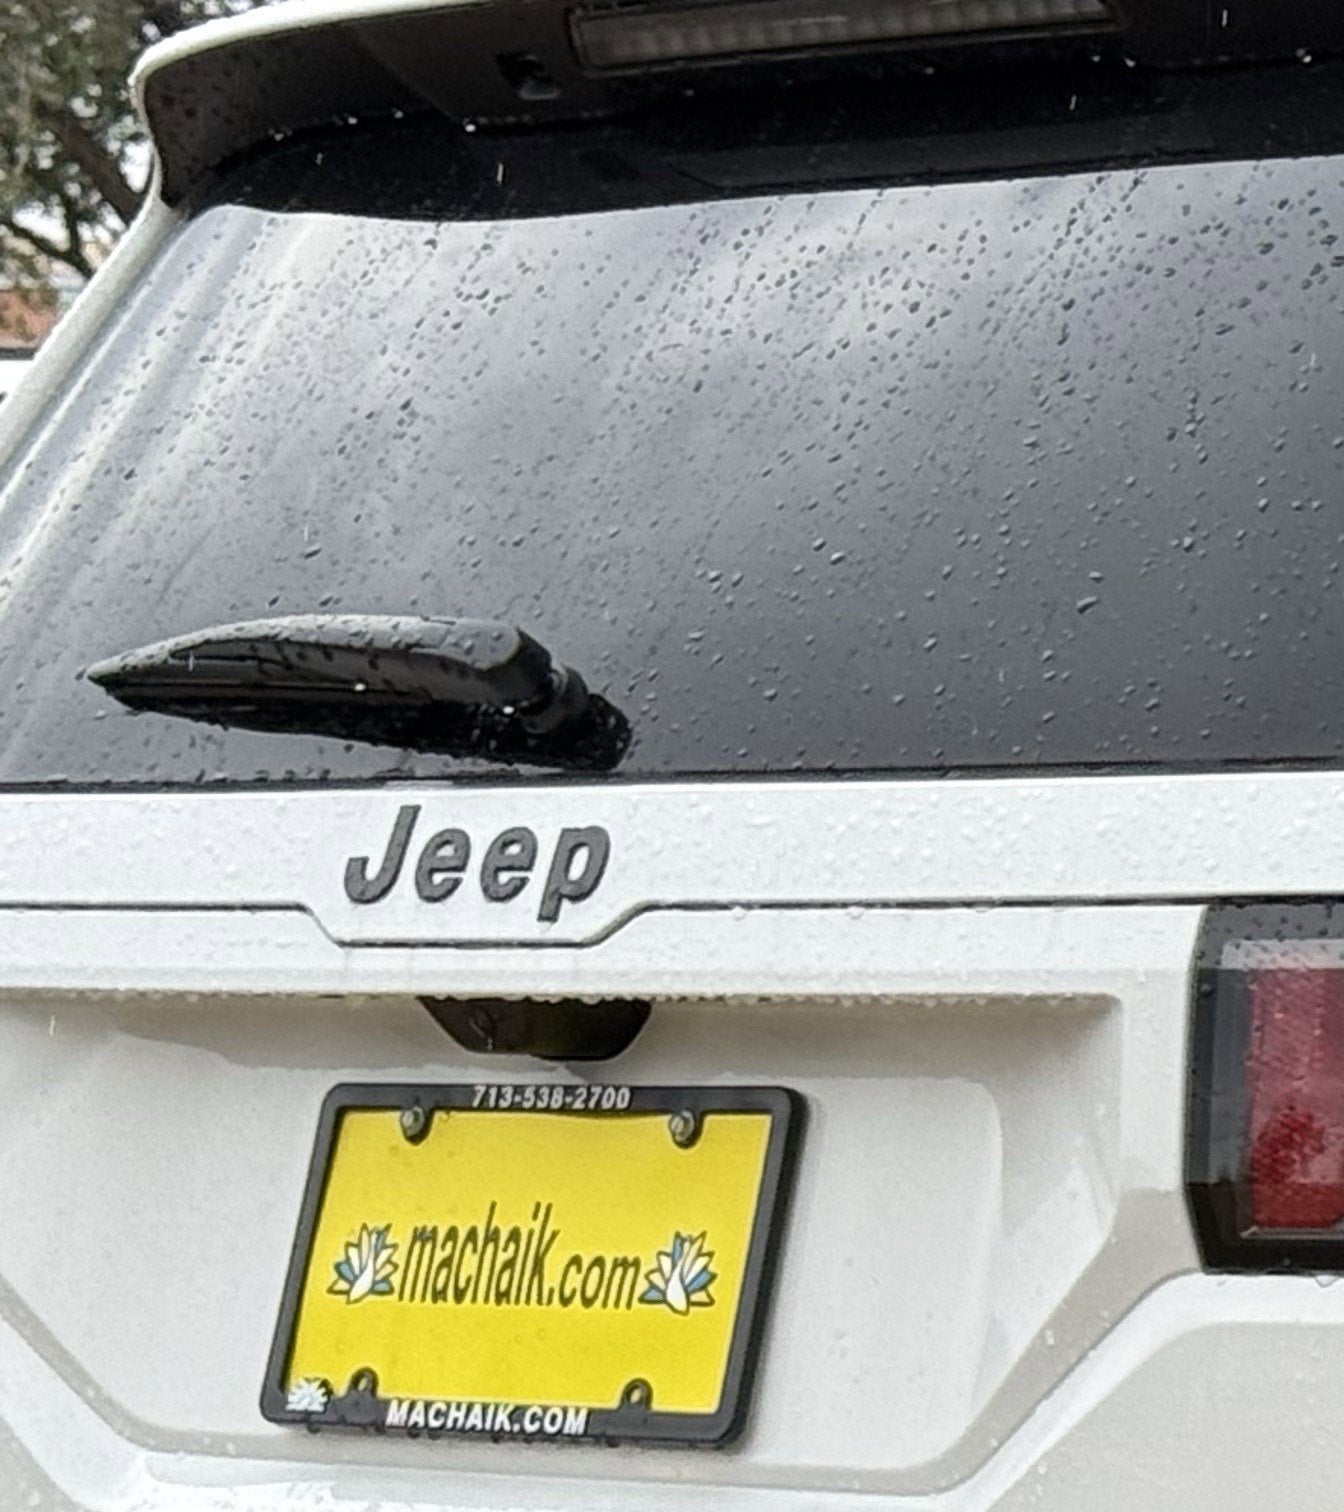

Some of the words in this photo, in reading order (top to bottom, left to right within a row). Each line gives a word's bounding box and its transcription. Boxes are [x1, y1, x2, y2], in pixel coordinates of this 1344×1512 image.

[343, 803, 612, 923] Jeep
[471, 1085, 631, 1110] 713-538-2700
[398, 1201, 642, 1310] machaik.com
[386, 1399, 589, 1435] MACHAIK.COM
